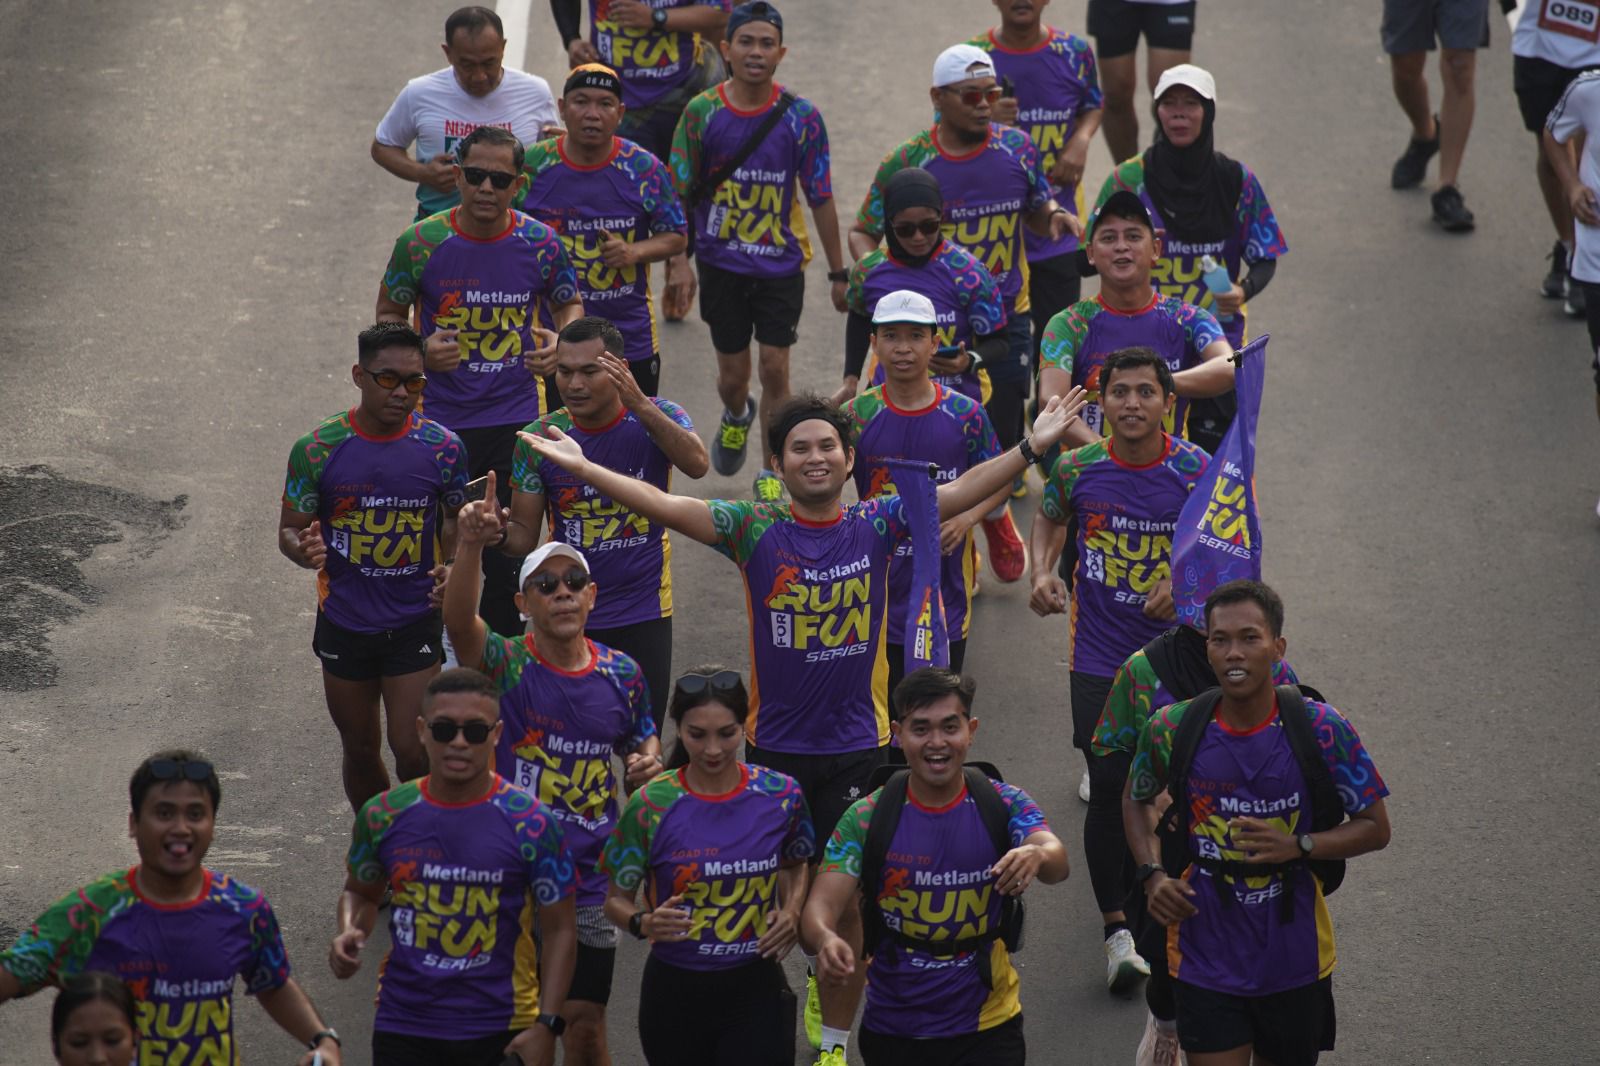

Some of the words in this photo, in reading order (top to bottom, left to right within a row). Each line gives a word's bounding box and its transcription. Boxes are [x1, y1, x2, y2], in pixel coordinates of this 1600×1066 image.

[1550, 3, 1594, 25] 089
[612, 35, 680, 68] FUN
[1016, 107, 1072, 121] etland
[713, 178, 784, 216] RUN
[567, 216, 635, 231] Metland
[718, 208, 787, 247] FUN
[466, 290, 531, 304] Metland
[436, 305, 527, 331] RUN
[457, 330, 522, 362] FUN
[361, 495, 429, 508] Metland
[329, 508, 427, 534] RUN
[349, 532, 423, 569] FUN
[1199, 533, 1253, 560] SERIES
[360, 562, 421, 577] SERIES
[769, 572, 871, 613] RUN
[794, 603, 872, 650] FUN
[804, 641, 870, 663] SERIES
[1219, 791, 1301, 814] Metland
[422, 863, 504, 884] Metland
[704, 853, 778, 877] Metland
[914, 864, 993, 887] Metland
[391, 880, 502, 918] RUN
[681, 872, 779, 907] RUN
[879, 883, 993, 924] RUN
[688, 900, 771, 943] FUN
[414, 913, 499, 959] FUN
[697, 940, 759, 956] SERIE
